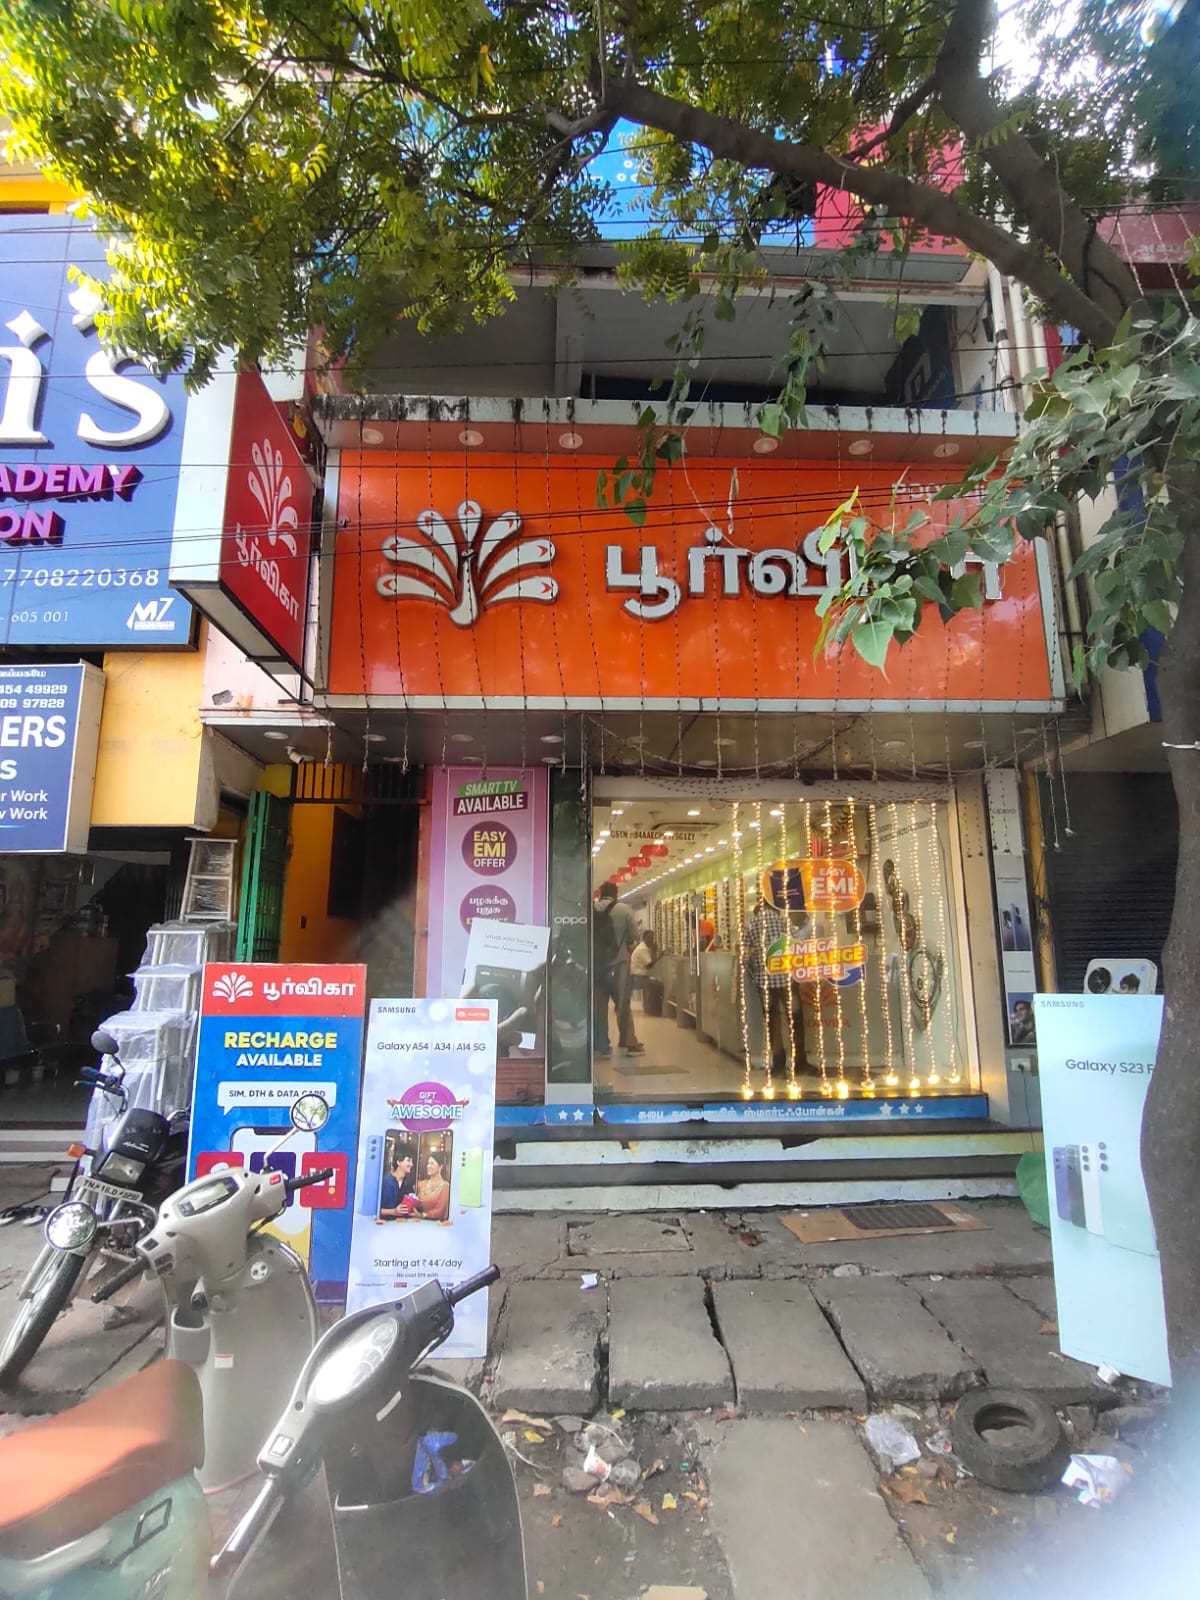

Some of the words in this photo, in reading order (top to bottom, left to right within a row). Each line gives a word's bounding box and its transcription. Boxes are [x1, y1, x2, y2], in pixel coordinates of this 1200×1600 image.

[3, 569, 159, 587] 7708220368
[11, 611, 37, 623] 605
[43, 611, 69, 623] 001
[465, 781, 501, 796] SMART
[504, 779, 518, 791] TV
[10, 789, 48, 802] Work
[457, 794, 524, 814] AVAILABLE
[9, 807, 48, 820] Work
[473, 831, 507, 842] EASY
[473, 842, 507, 857] EMI
[473, 858, 506, 868] OFFER
[814, 877, 856, 895] EMI
[263, 977, 356, 1000] பூர்விகா
[377, 1006, 417, 1014] SAMSUNG
[1039, 1000, 1085, 1008] SAMSUNG
[224, 1031, 337, 1049] RECHARGE
[376, 1041, 411, 1053] Galaxy
[412, 1042, 429, 1051] A54
[434, 1042, 451, 1051] A34
[456, 1043, 471, 1051] A14
[235, 1053, 323, 1067] AVAILABLE
[1065, 1058, 1117, 1074] Galaxy
[1119, 1062, 1144, 1074] S23
[391, 1104, 463, 1120] AWESOME
[373, 1258, 409, 1270] Starting
[410, 1259, 420, 1268] at
